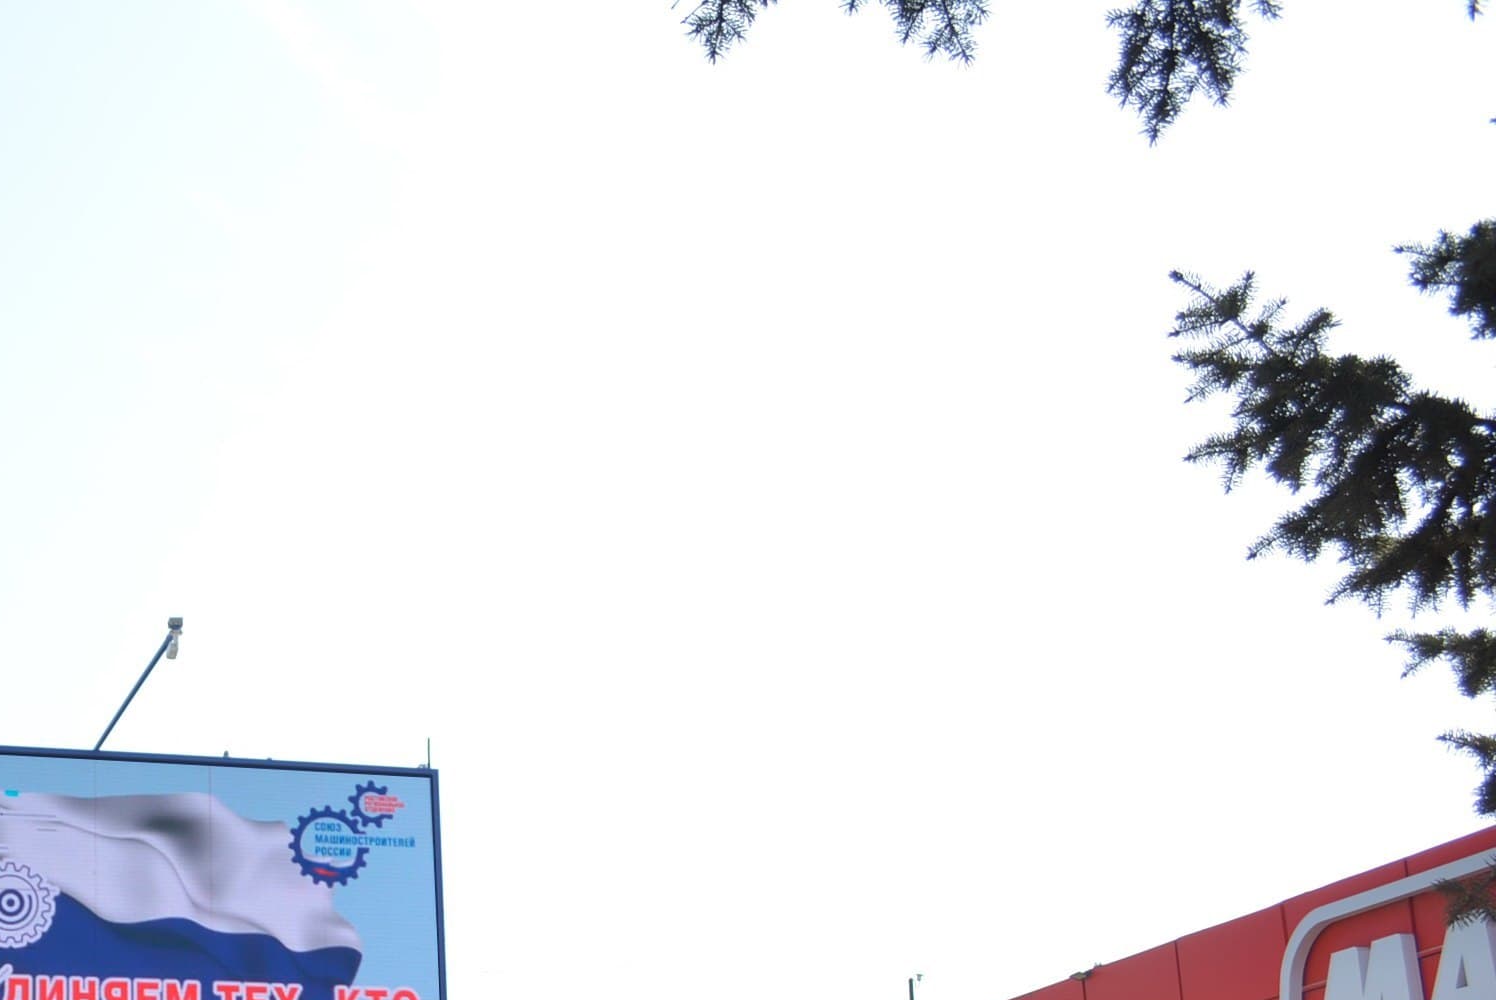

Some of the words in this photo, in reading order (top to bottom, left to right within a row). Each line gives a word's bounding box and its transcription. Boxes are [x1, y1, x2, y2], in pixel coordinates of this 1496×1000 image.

[314, 822, 342, 832] СОЮЗ
[314, 833, 416, 848] МАШИНОСТРОИТЕЛЕЙ
[314, 845, 352, 857] РОССИИ
